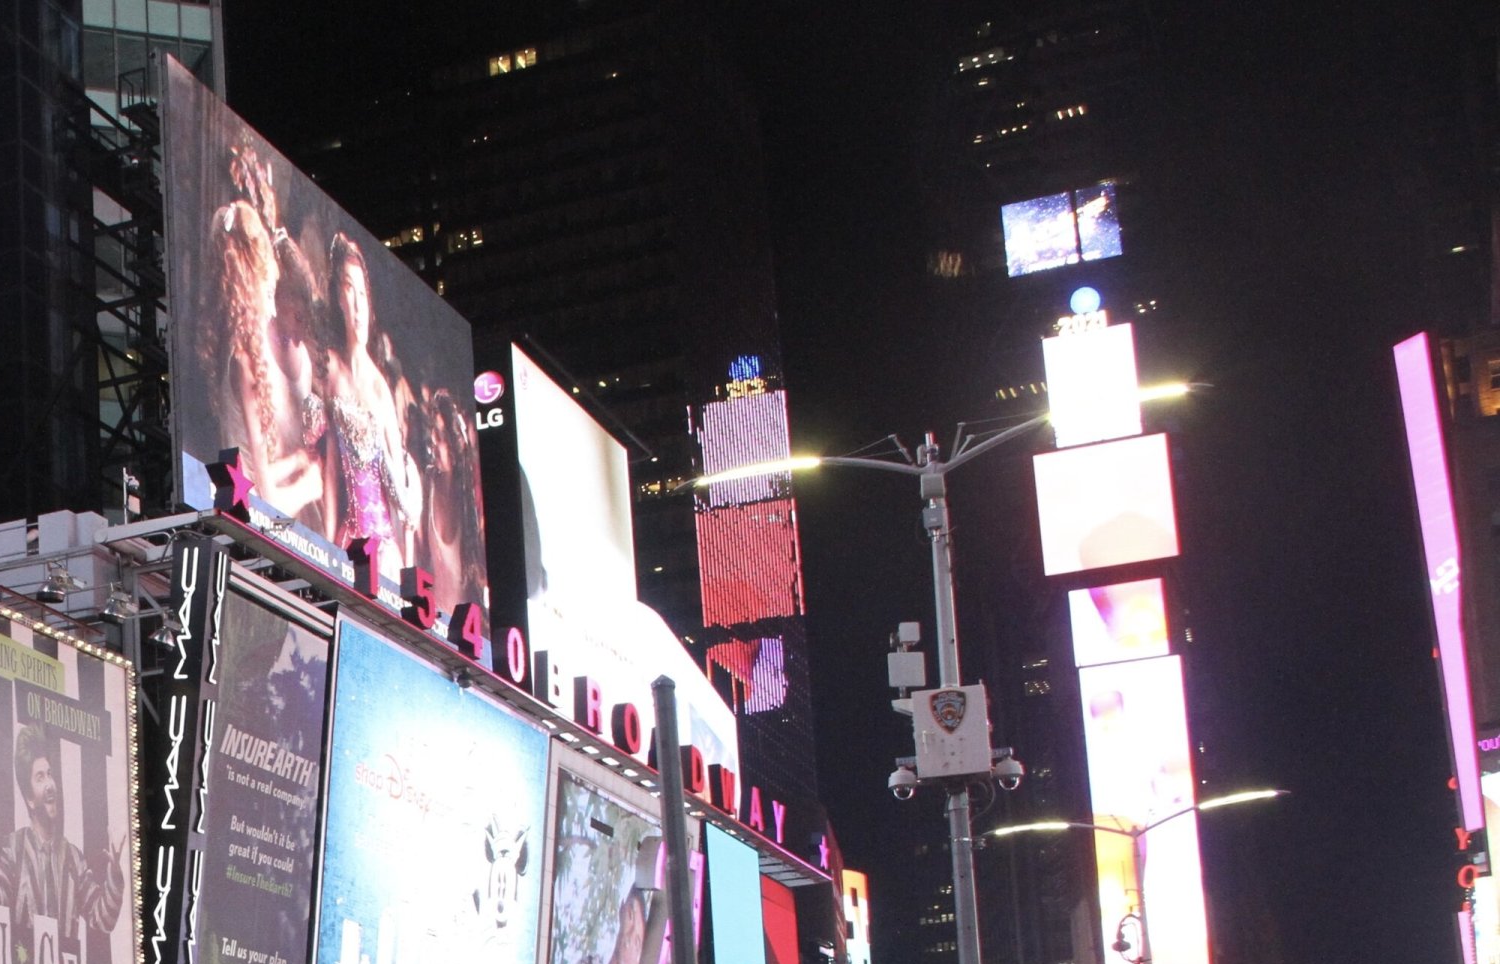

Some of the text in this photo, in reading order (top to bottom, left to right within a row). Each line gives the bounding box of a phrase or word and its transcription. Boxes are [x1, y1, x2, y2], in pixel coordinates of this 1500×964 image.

[476, 407, 504, 430] LG
[20, 653, 58, 690] SPIRITS
[27, 691, 101, 741] ON BROADWAY!
[540, 648, 786, 844] BRODWAY
[236, 773, 249, 787] not
[250, 779, 255, 788] a
[257, 781, 272, 795] real
[231, 815, 295, 851] But wouldn't it be
[229, 843, 294, 873] great if you could
[221, 937, 237, 957] Tell
[237, 947, 247, 959] us
[248, 950, 268, 964] your
